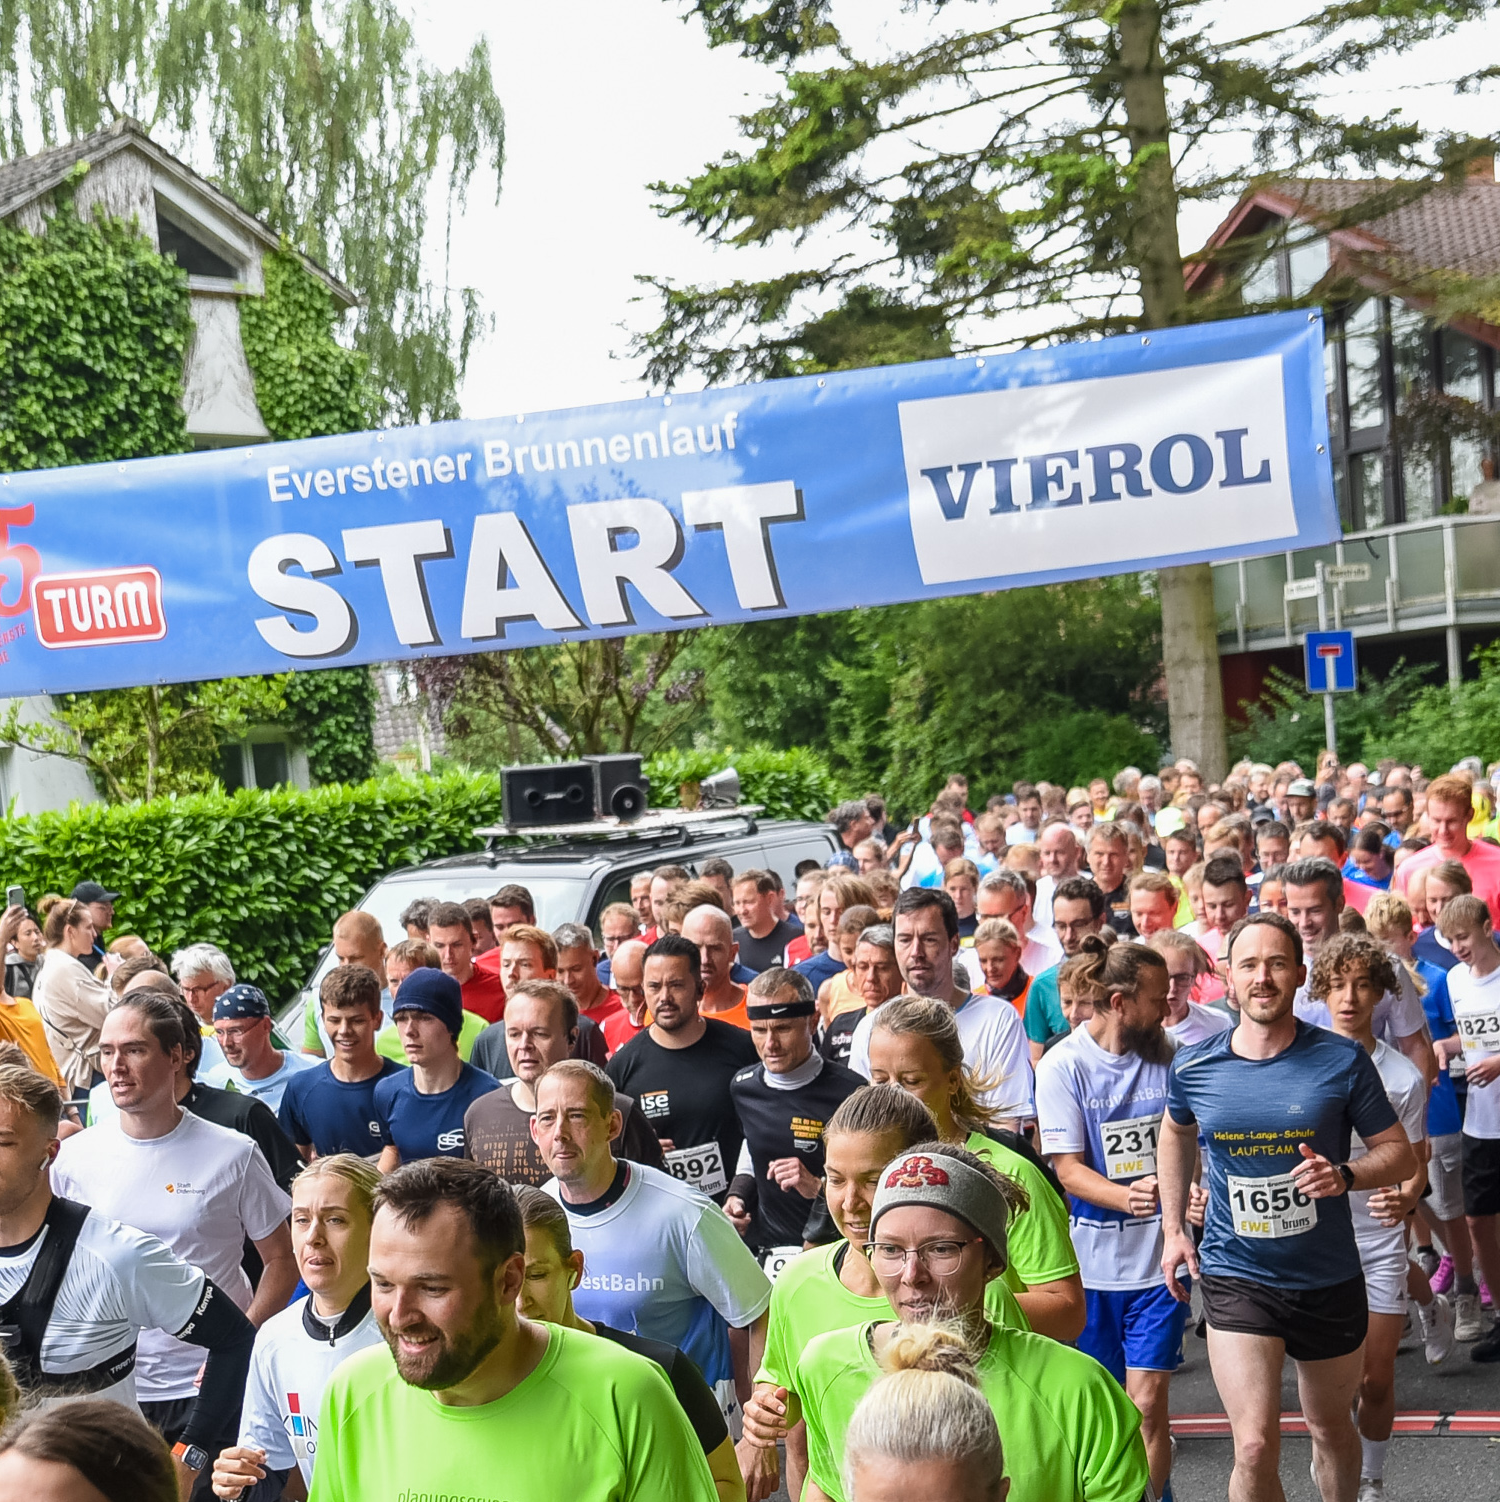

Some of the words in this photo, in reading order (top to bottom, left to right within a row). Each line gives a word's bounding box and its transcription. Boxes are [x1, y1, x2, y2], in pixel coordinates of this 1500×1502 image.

[267, 453, 472, 503] Everstener
[484, 413, 738, 478] Brunnenlauf
[920, 428, 1272, 522] VIEROL
[247, 480, 806, 660] START
[43, 580, 153, 633] TURM
[1457, 1016, 1500, 1036] 1823
[1105, 1126, 1158, 1157] 231
[1213, 1129, 1316, 1141] Helene-Lange-Schule
[1229, 1144, 1295, 1157] LAUFTEAM
[670, 1153, 722, 1182] 892
[1115, 1160, 1144, 1174] EWE
[1232, 1187, 1312, 1214] 1656
[1241, 1220, 1271, 1233] EWE
[1281, 1216, 1310, 1230] bruns
[580, 1271, 665, 1292] estBahn
[195, 1285, 214, 1316] Kempa
[177, 1322, 196, 1340] empa
